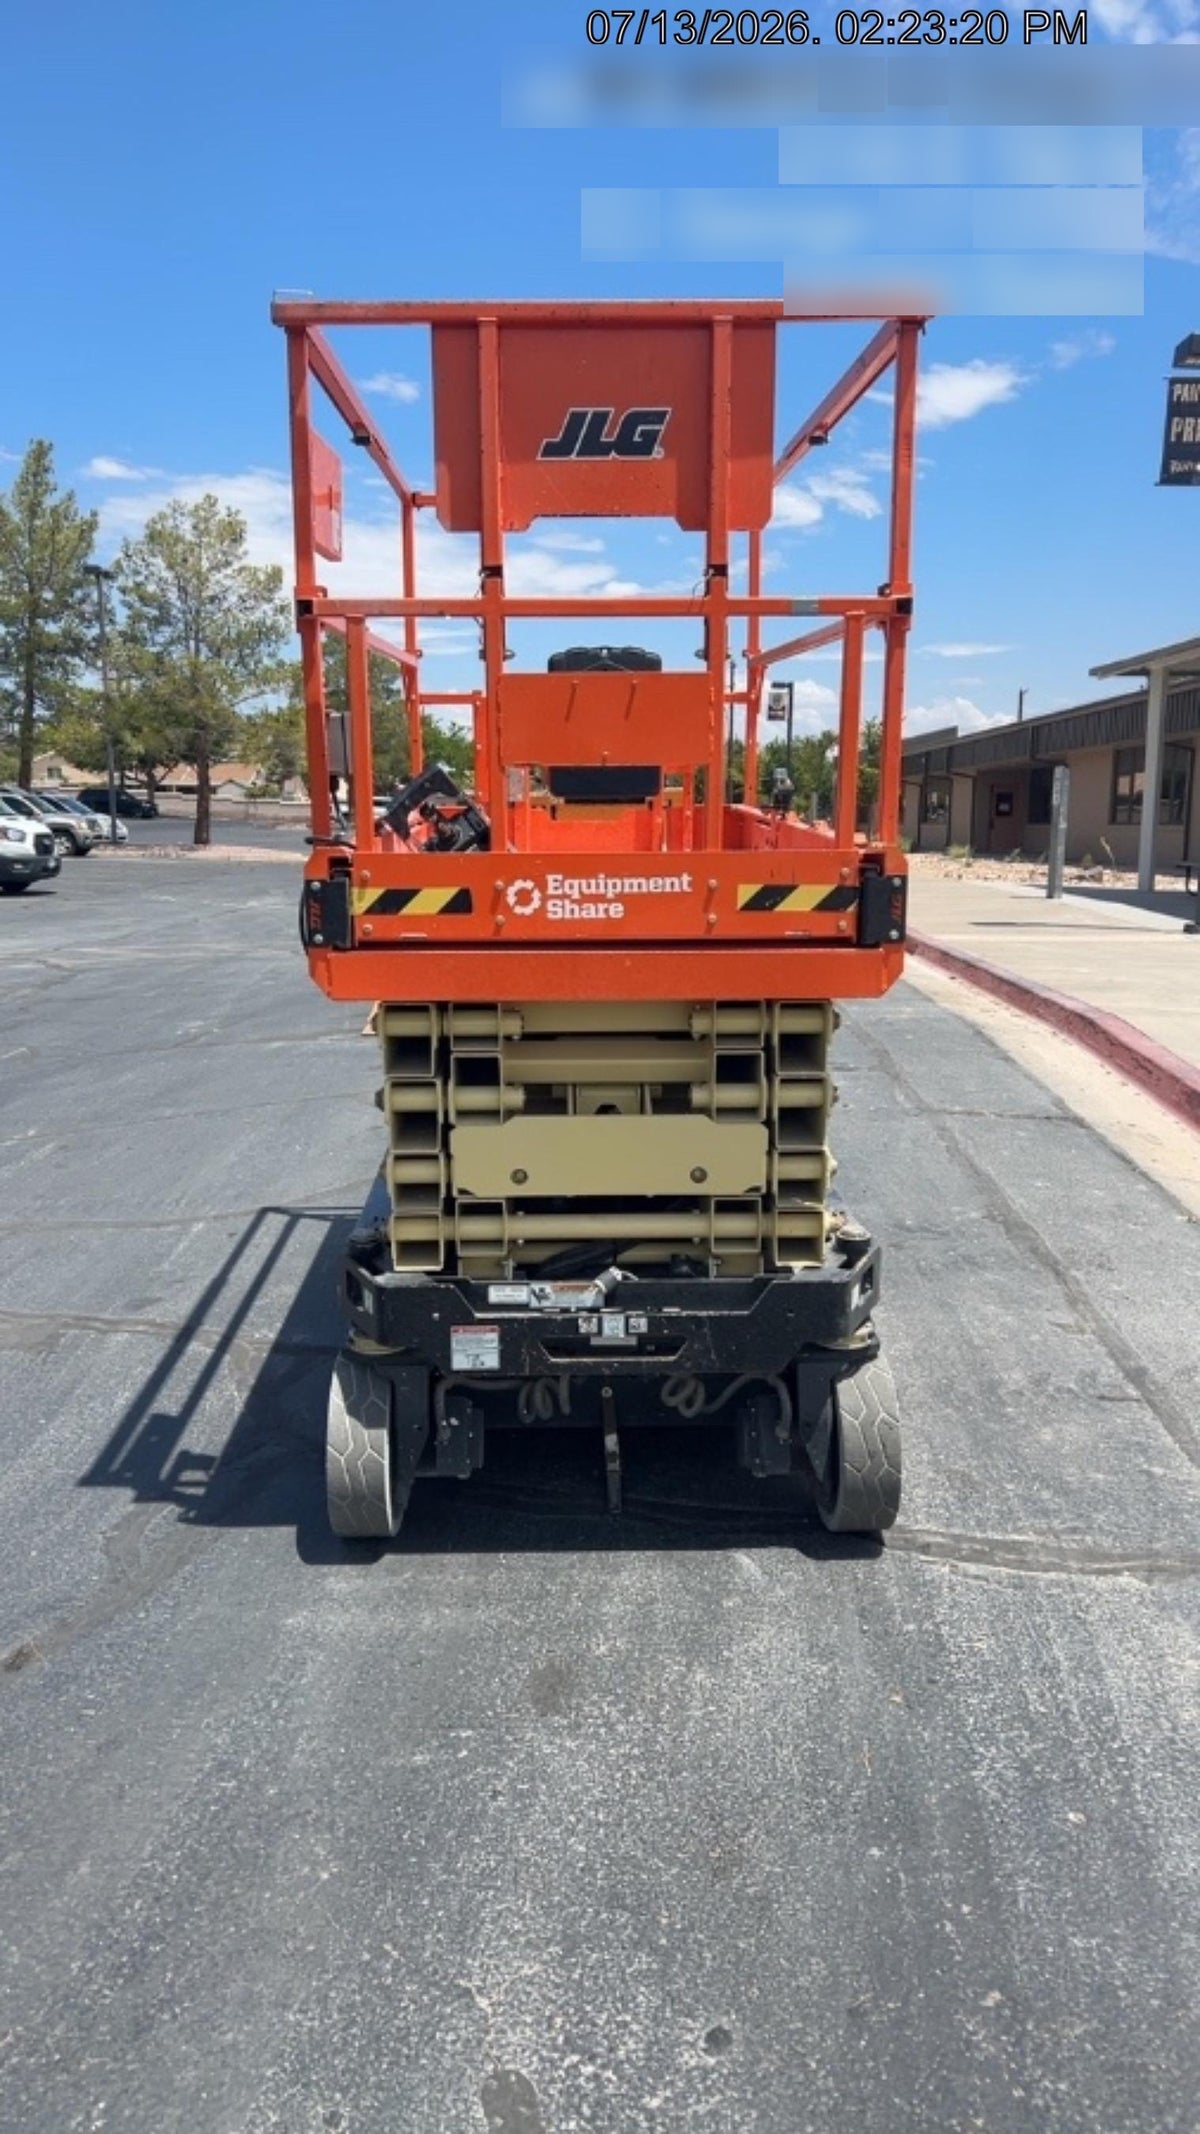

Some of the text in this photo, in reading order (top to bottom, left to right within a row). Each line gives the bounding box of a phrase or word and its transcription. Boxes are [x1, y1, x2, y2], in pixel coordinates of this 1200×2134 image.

[1173, 383, 1200, 402] PAN
[536, 407, 672, 460] JLG
[545, 872, 693, 898] Equipment
[546, 899, 625, 919] Share
